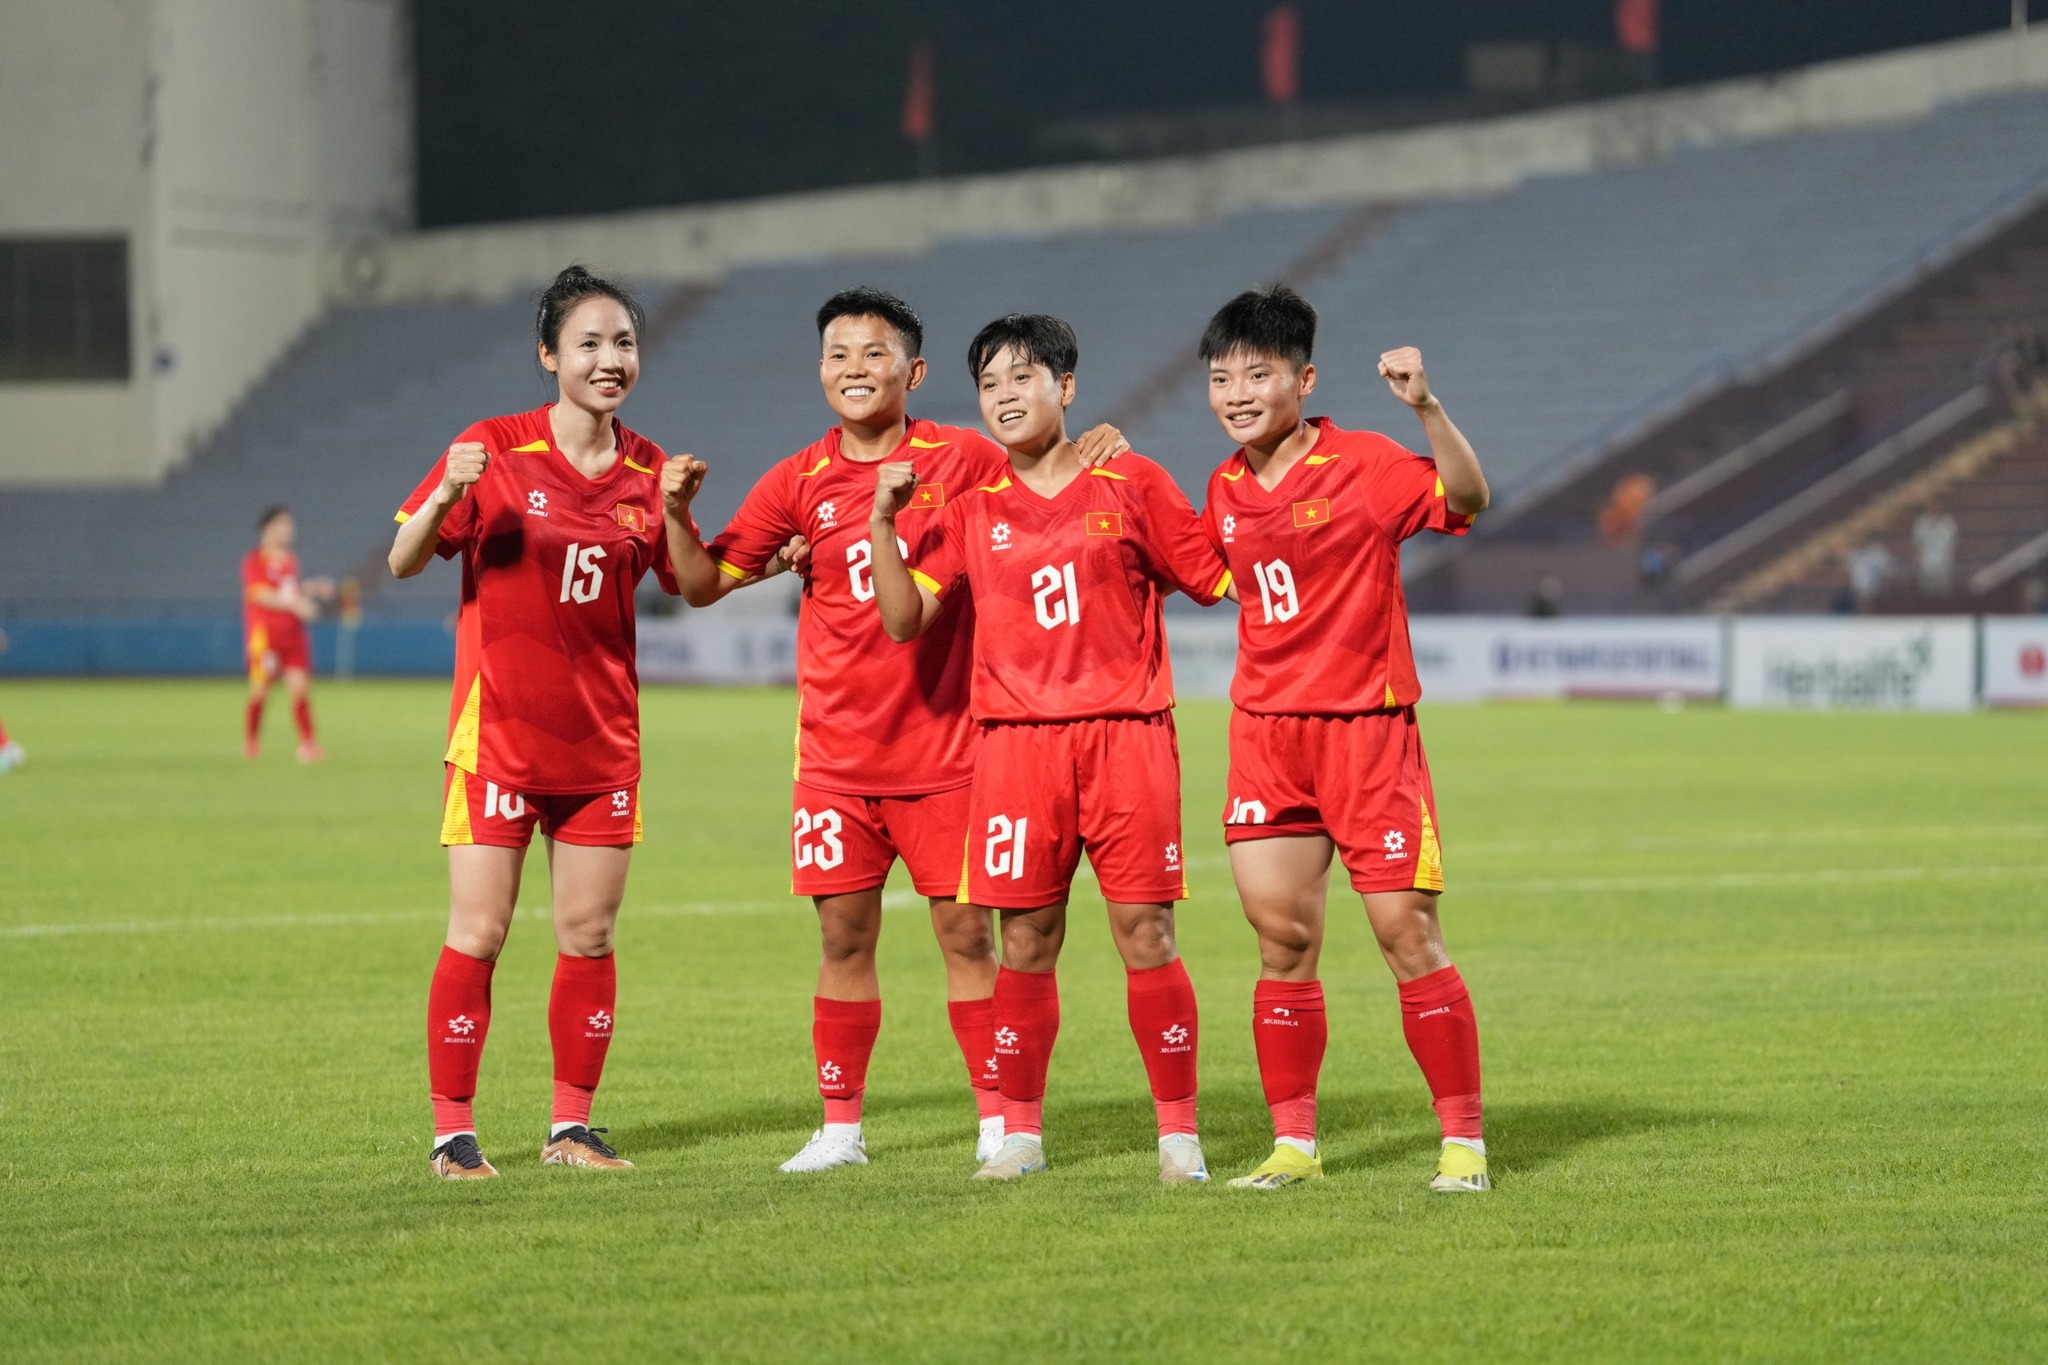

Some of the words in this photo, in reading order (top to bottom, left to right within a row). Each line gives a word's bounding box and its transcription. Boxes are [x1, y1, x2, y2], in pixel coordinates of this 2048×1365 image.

[560, 543, 607, 604] 15
[847, 537, 908, 603] 2
[1031, 561, 1080, 630] 21
[1253, 558, 1300, 625] 19
[794, 808, 844, 871] 23
[984, 814, 1028, 880] 21
